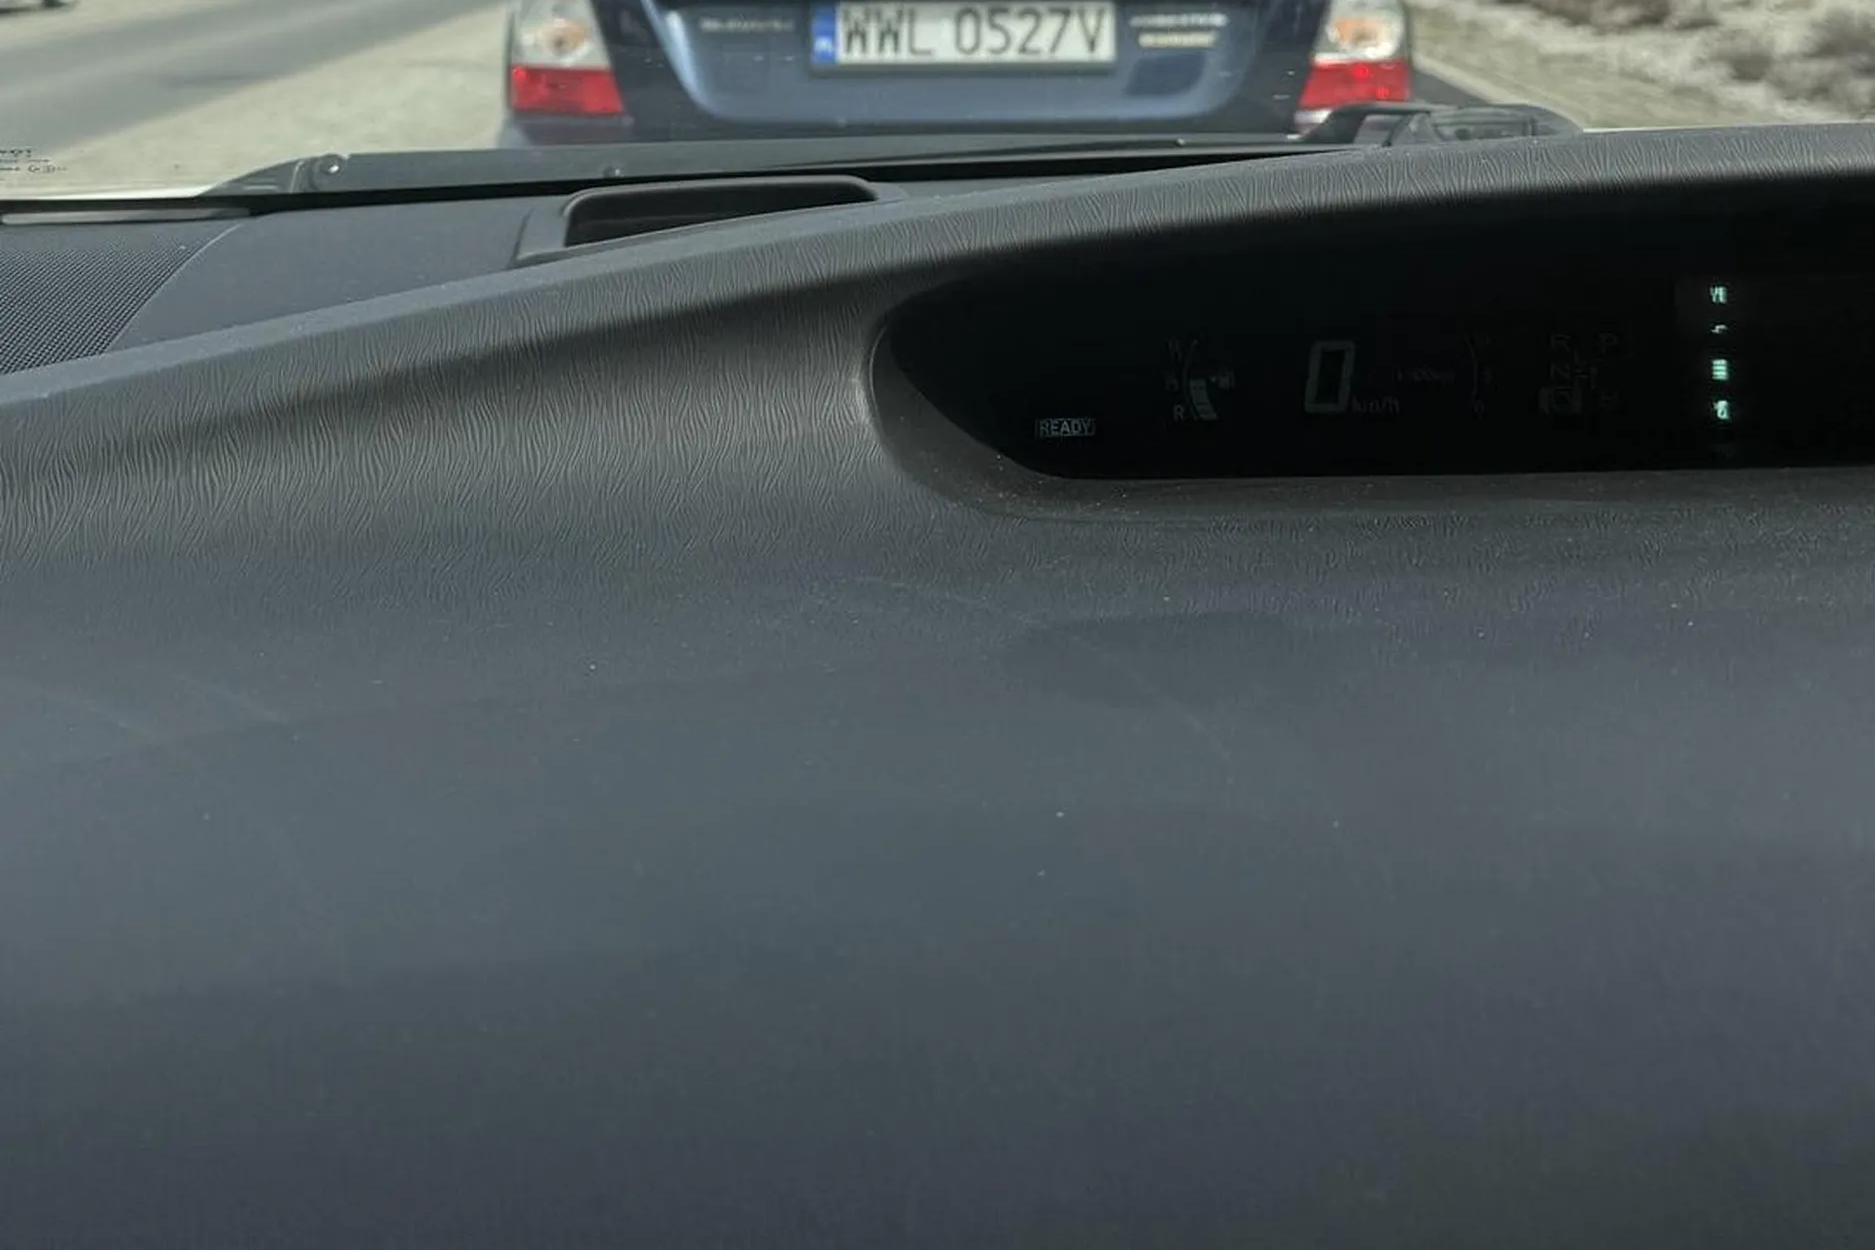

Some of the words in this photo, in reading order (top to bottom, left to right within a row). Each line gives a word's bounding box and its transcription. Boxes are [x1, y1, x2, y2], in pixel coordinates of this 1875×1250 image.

[841, 5, 931, 56] WWL
[1304, 339, 1357, 415] 0
[1040, 418, 1091, 438] READY
